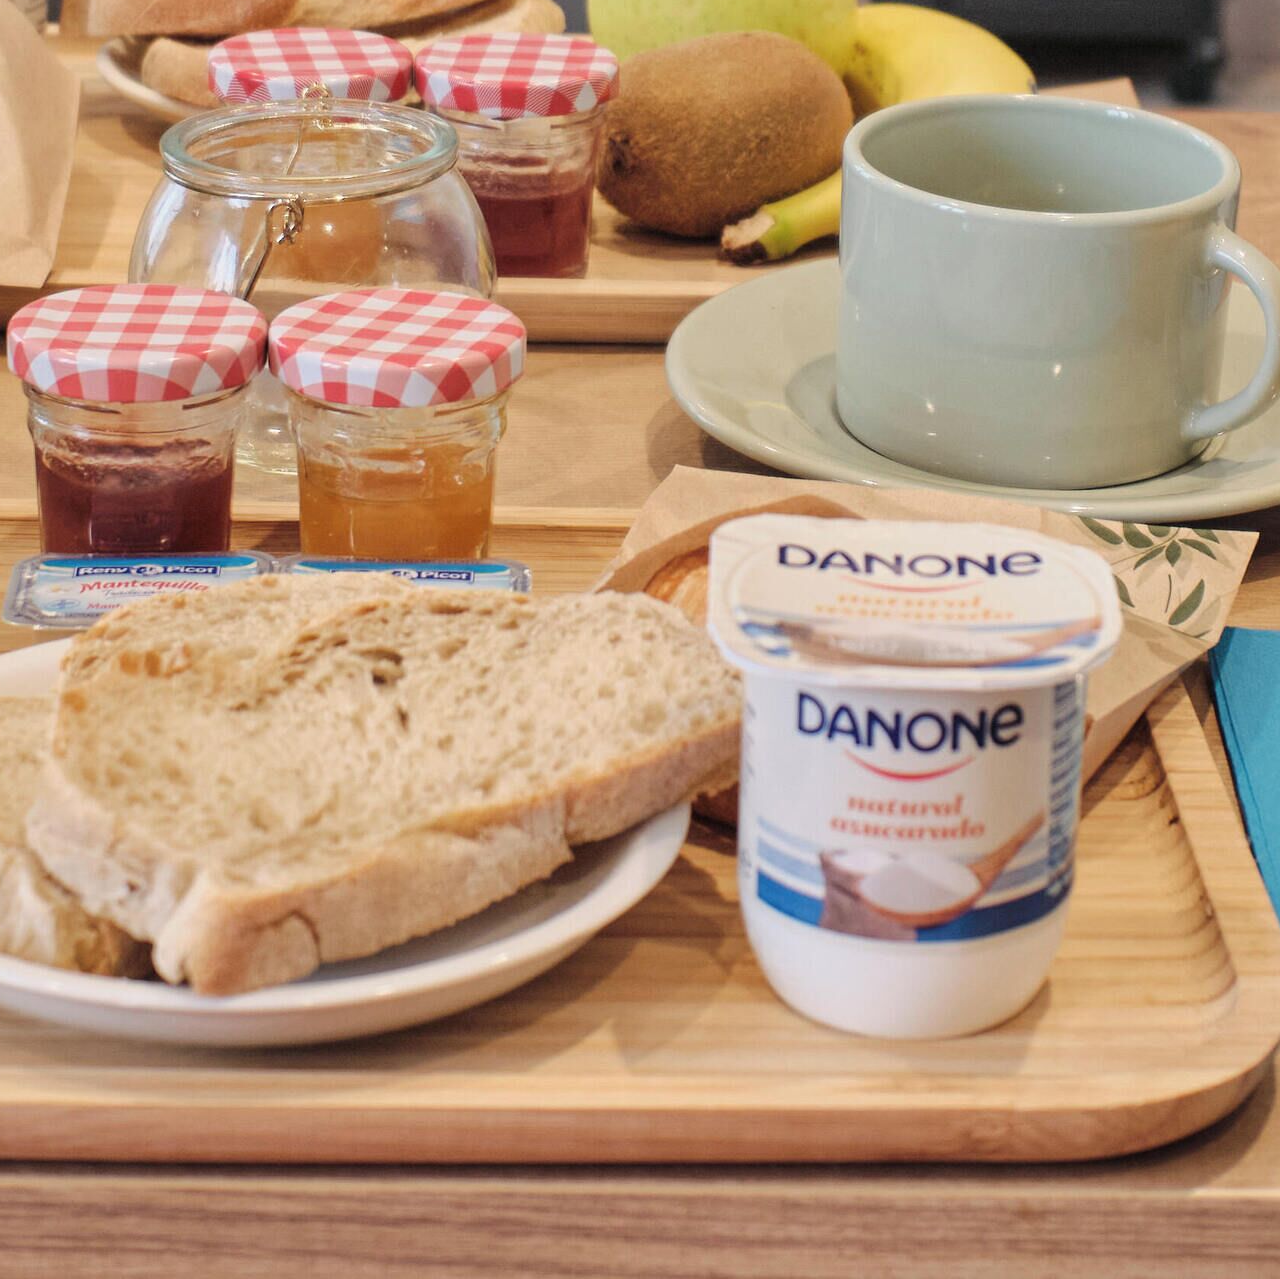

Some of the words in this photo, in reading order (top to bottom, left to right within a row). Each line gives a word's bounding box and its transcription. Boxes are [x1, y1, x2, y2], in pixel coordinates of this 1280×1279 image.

[166, 565, 215, 574] Picot
[420, 570, 470, 580] Picot
[80, 579, 211, 594] Mantequilla
[847, 793, 965, 816] natural
[829, 816, 987, 840] azucarado
